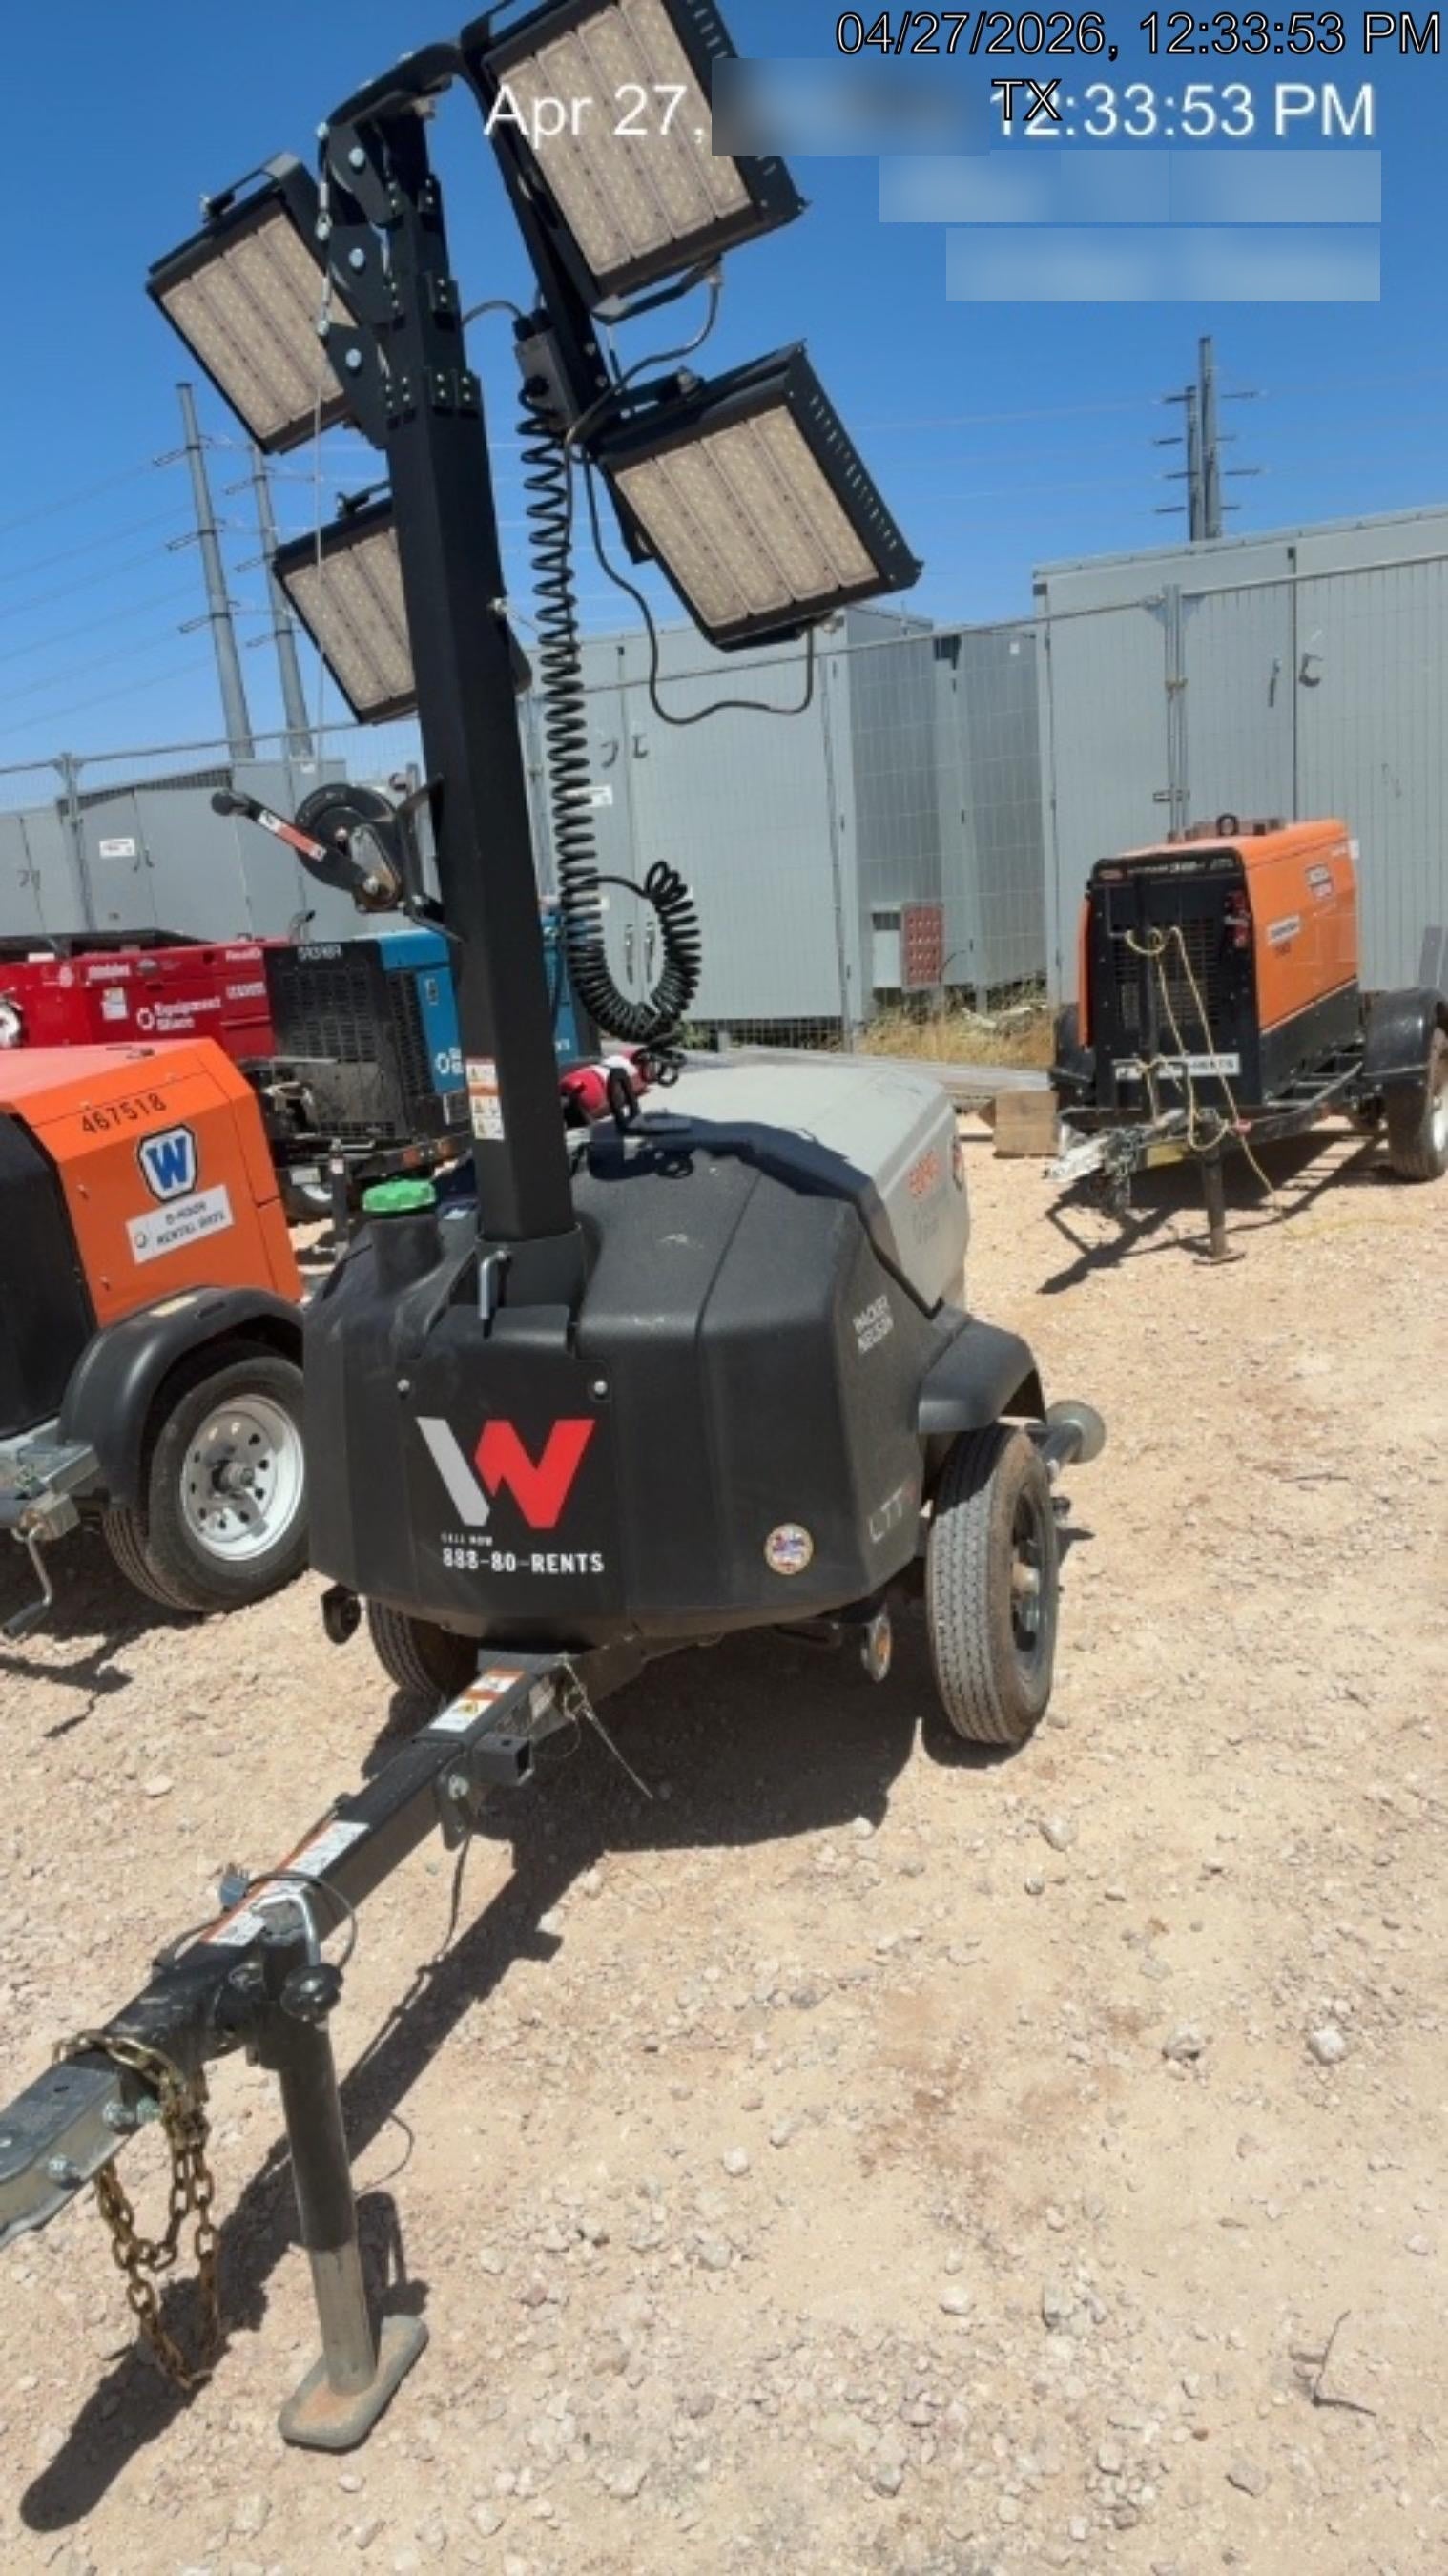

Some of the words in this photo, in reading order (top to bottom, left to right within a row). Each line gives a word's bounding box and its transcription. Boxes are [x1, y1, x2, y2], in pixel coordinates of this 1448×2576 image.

[82, 1093, 167, 1133] 467518
[145, 1135, 188, 1192] W
[443, 1547, 605, 1573] 888-80-RENTS
